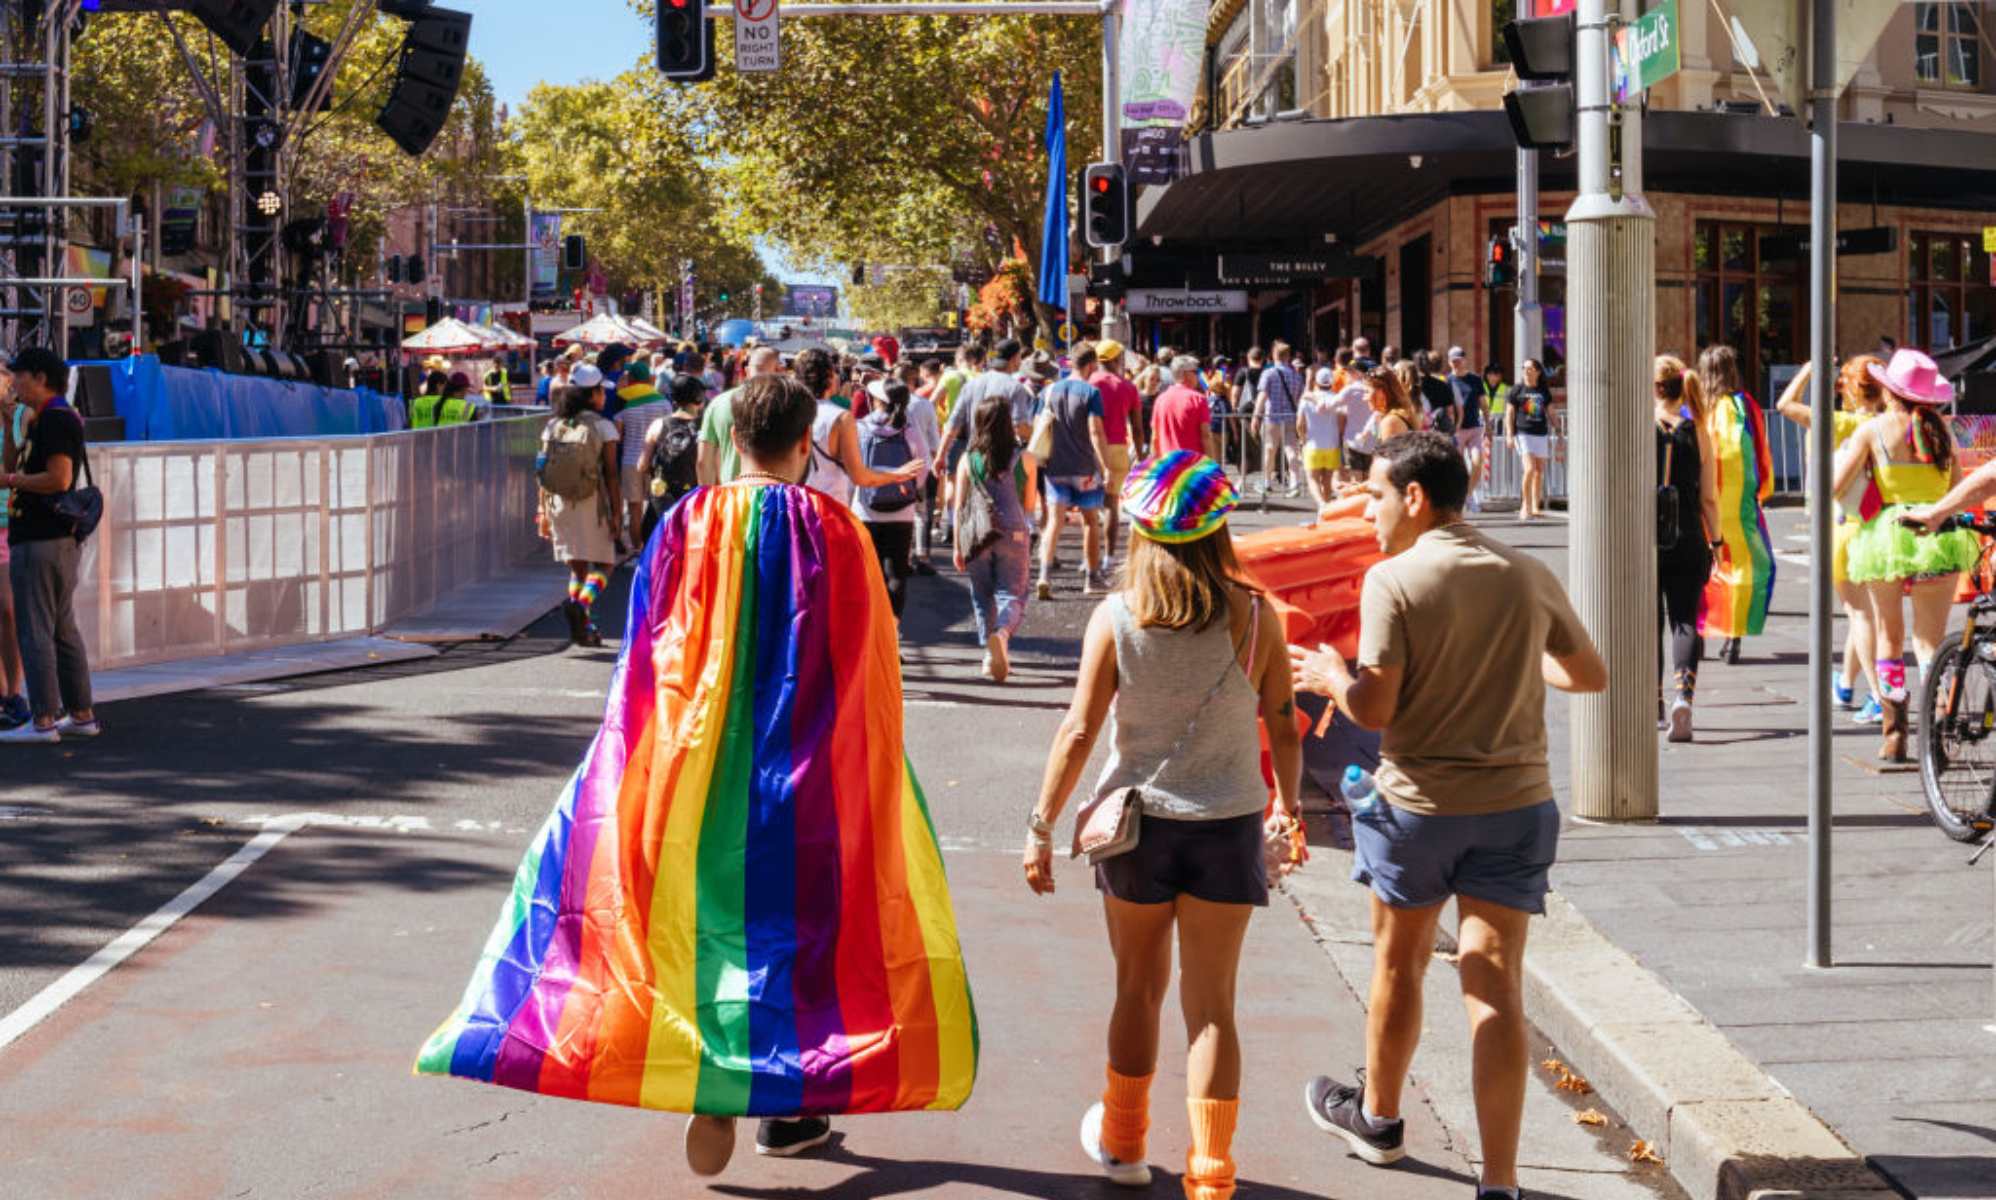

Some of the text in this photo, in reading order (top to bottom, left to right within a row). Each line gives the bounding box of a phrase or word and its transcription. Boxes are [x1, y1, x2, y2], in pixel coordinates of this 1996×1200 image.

[744, 26, 769, 40] NO
[1659, 13, 1669, 50] St
[740, 43, 774, 53] RIGHT
[743, 56, 775, 65] TURN
[1269, 262, 1327, 271] THE RILEY
[70, 293, 86, 306] 40
[1145, 294, 1227, 308] Throwback.
